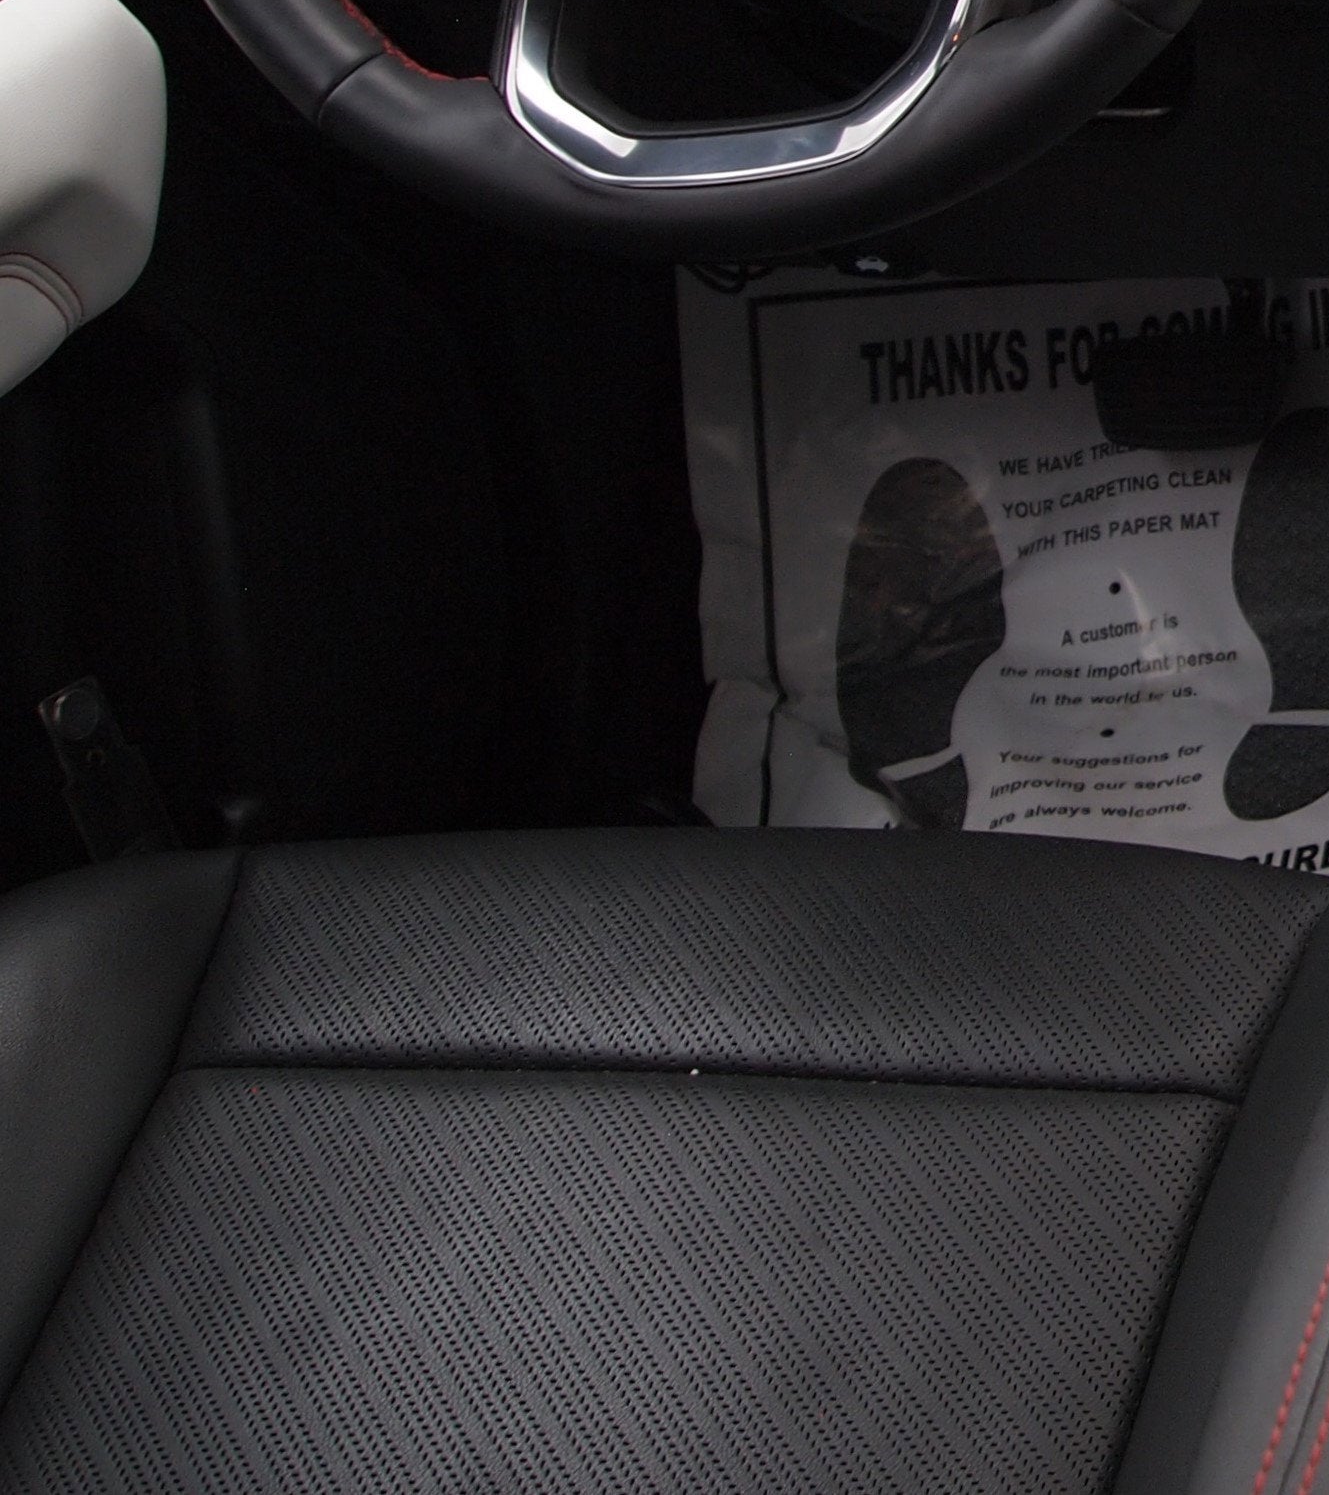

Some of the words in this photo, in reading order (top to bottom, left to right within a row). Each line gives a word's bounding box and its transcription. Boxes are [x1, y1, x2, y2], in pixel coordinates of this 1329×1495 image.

[860, 328, 1030, 404] THANKS
[998, 459, 1029, 477] WE
[1036, 450, 1084, 474] HAVE
[1002, 499, 1055, 519] YOUR
[1059, 473, 1160, 510] CARPETING
[1168, 468, 1232, 489] CLEAN
[1016, 532, 1056, 559] WITH
[1063, 524, 1101, 547] THIS
[1108, 514, 1174, 539] PAPER
[1179, 511, 1221, 531] MAT
[1061, 629, 1075, 647] A
[1163, 612, 1180, 630] is
[1000, 665, 1029, 679] the
[1034, 666, 1081, 679] most
[1086, 656, 1170, 681] important
[1176, 649, 1238, 673] person
[1054, 692, 1083, 706] the
[1090, 690, 1141, 705] world
[1171, 685, 1198, 699] us.
[998, 750, 1044, 766] Your
[1051, 751, 1170, 769] suggestions
[1177, 744, 1205, 759] for
[989, 777, 1087, 800] improving
[1093, 780, 1127, 792] our
[1133, 770, 1204, 791] service
[988, 810, 1016, 830] are
[1023, 804, 1092, 819] always
[1100, 800, 1193, 819] welcome.
